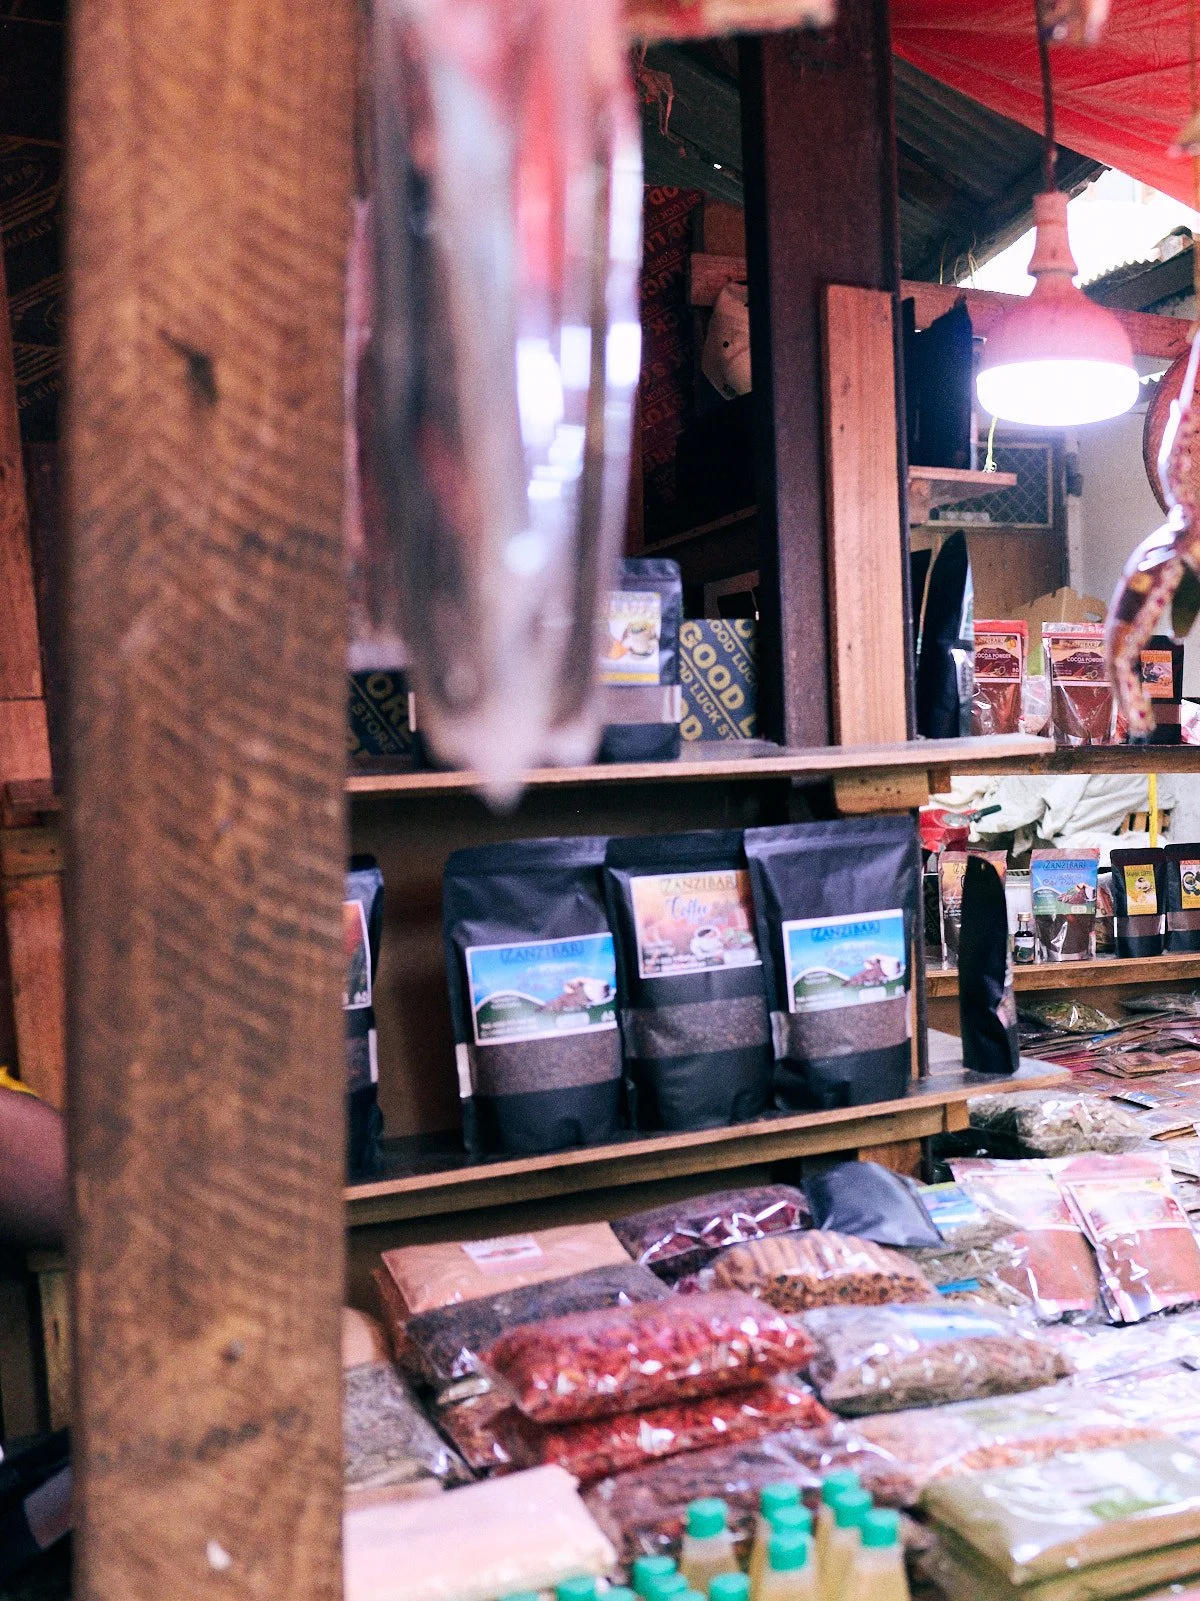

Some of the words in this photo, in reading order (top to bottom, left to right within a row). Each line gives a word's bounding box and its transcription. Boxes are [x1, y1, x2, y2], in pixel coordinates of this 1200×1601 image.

[680, 622, 745, 710] GOOD
[690, 683, 721, 725] LUCK
[1045, 860, 1084, 869] ZANZIBAR
[503, 942, 582, 962] ZANZIBAR
